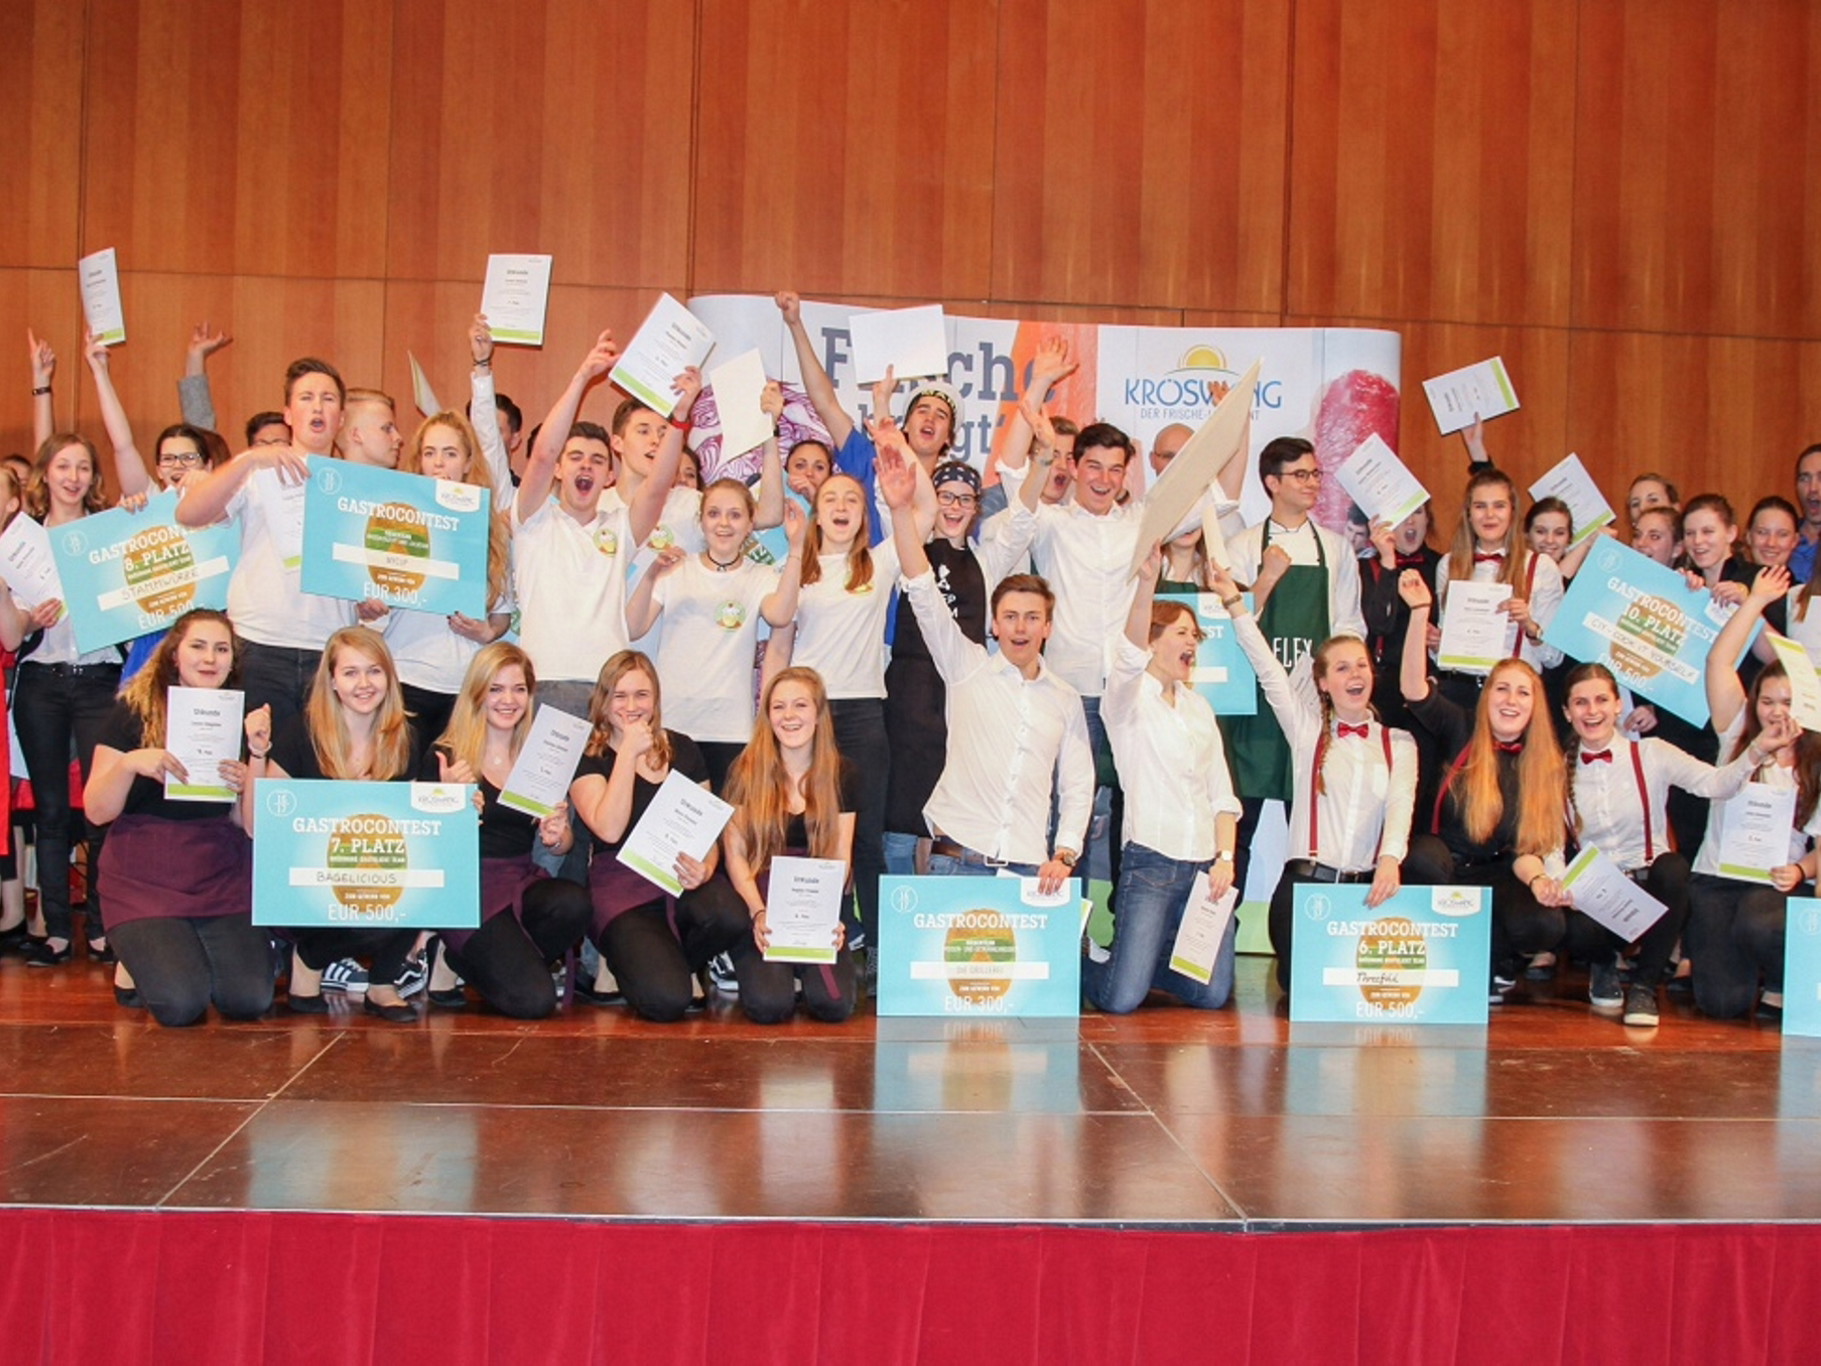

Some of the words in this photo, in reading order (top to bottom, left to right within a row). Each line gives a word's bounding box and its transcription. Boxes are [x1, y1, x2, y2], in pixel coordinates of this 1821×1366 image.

[337, 497, 460, 531] GASTROCONTEST
[143, 541, 190, 566] PLATZ
[364, 582, 390, 600] EUR
[138, 608, 168, 630] EUR
[1643, 615, 1686, 646] PLATZ
[293, 817, 442, 836] GASTROCONTEST
[331, 838, 345, 853] 7.
[351, 838, 405, 854] PLATZ
[316, 871, 398, 884] BAGELICIOUS
[328, 903, 361, 921] EUR
[366, 903, 407, 923] 500,-
[914, 913, 1048, 929] GASTROCONTEST
[1327, 920, 1459, 938] GASTROCONTEST
[1358, 940, 1373, 955] 6.
[1378, 940, 1426, 955] PLATZ
[944, 996, 974, 1012] EUR
[979, 996, 1015, 1015] 300,-
[1356, 1002, 1385, 1018] EUR
[1389, 1003, 1425, 1020] 500,-
